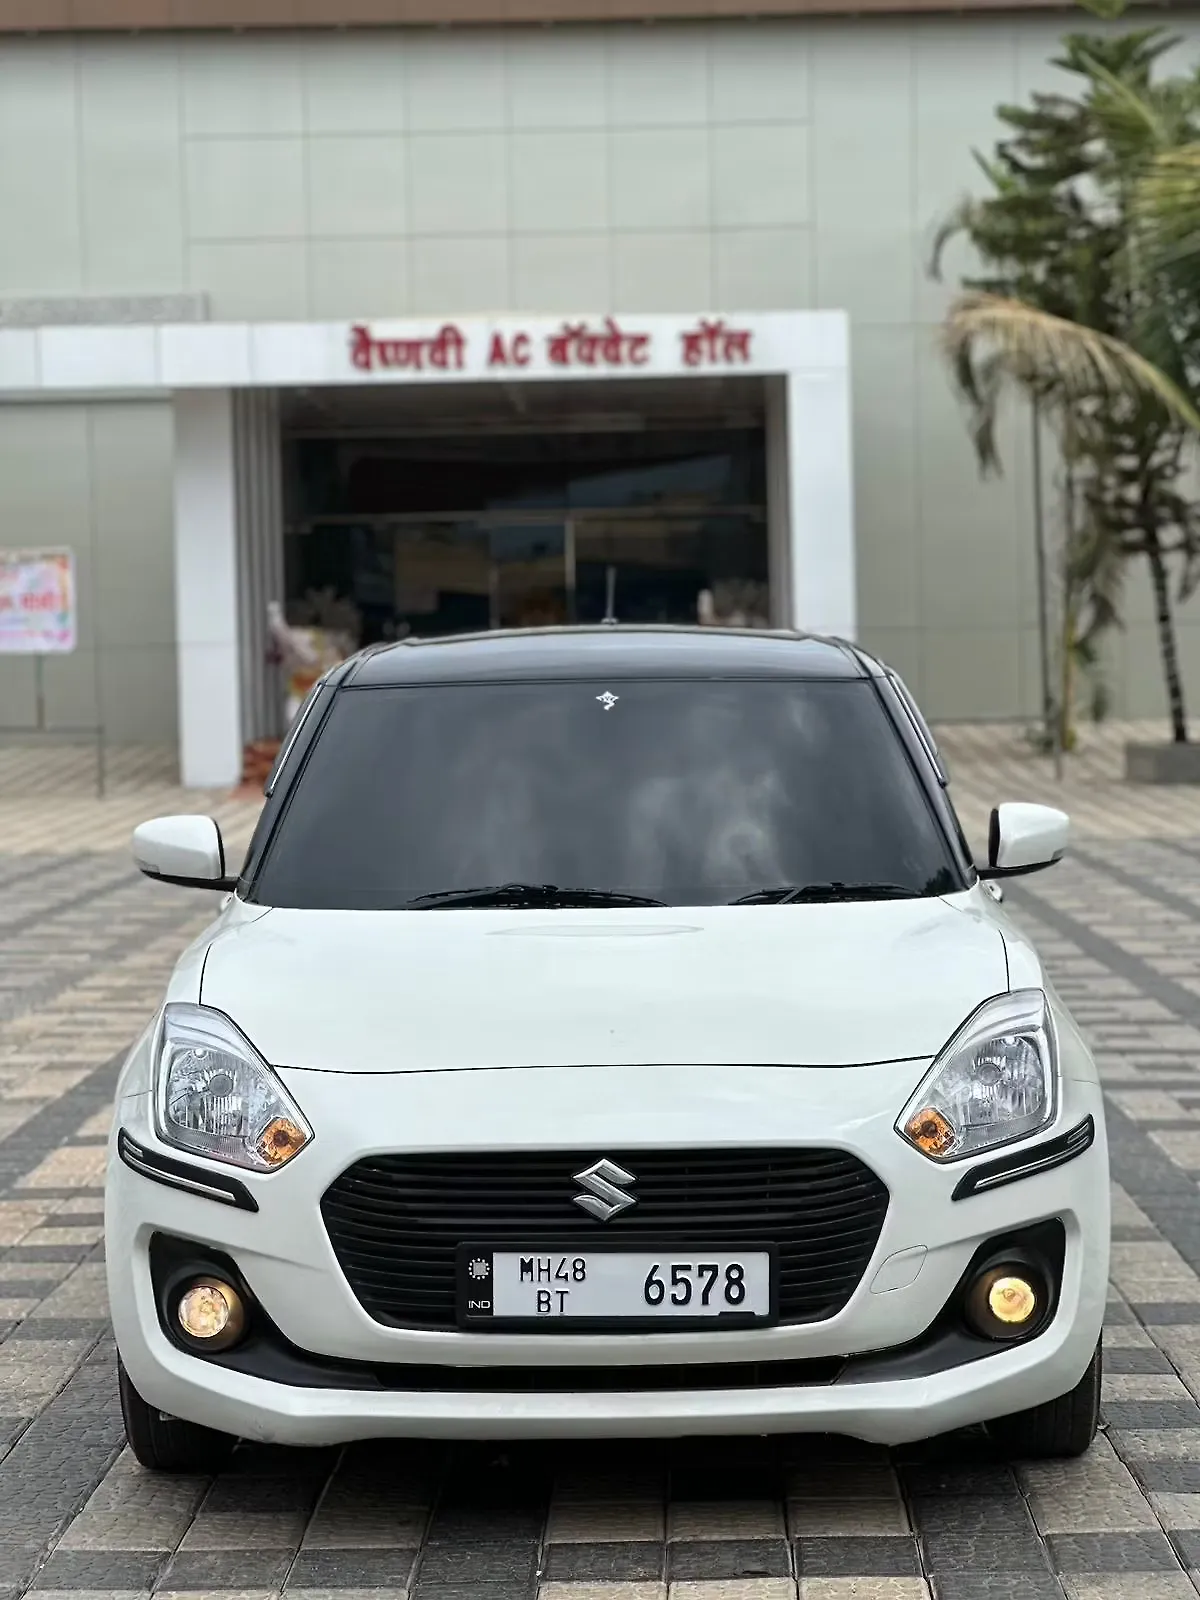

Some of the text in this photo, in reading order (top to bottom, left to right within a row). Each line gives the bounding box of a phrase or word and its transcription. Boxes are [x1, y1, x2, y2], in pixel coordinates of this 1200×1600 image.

[487, 332, 530, 367] AC
[519, 1257, 586, 1282] MH48
[643, 1263, 746, 1306] 6578
[468, 1300, 491, 1309] IND
[537, 1289, 569, 1313] BT
